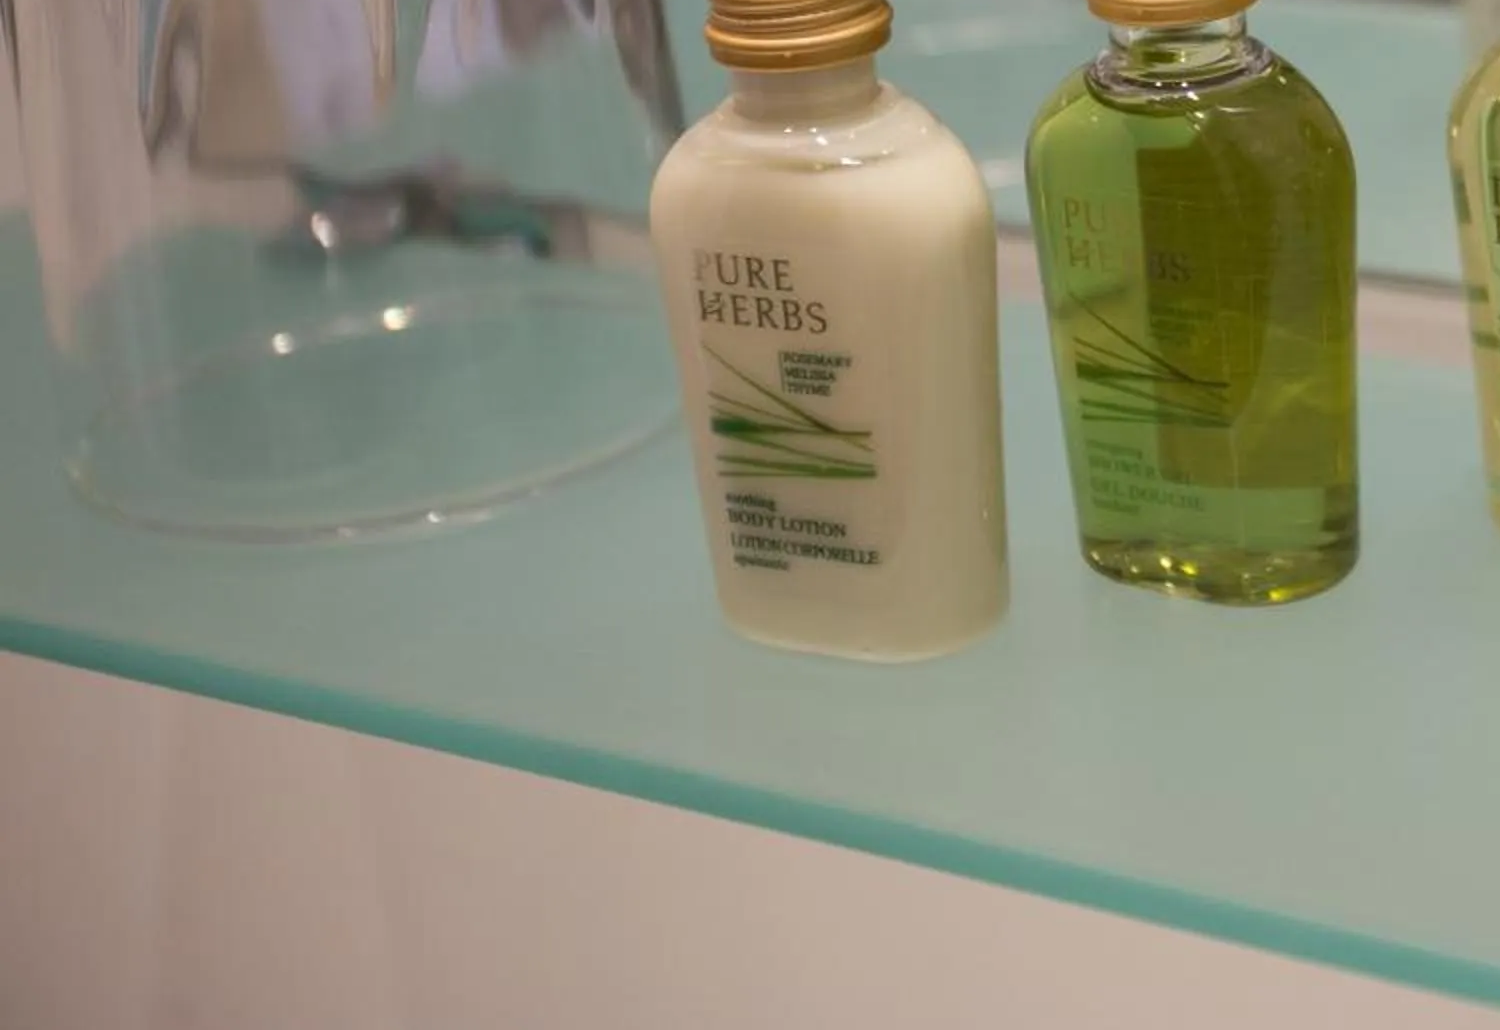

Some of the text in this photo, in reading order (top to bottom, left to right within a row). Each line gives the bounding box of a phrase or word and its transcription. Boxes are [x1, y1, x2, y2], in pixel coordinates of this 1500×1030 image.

[692, 248, 794, 292] PURE
[696, 289, 828, 335] HERBS
[783, 351, 853, 368] ROSEMARY
[784, 367, 837, 383] MELISSA
[786, 380, 832, 397] THYME
[726, 507, 847, 539] BODY LOTION
[730, 532, 881, 566] LOTION CORPORELLE
